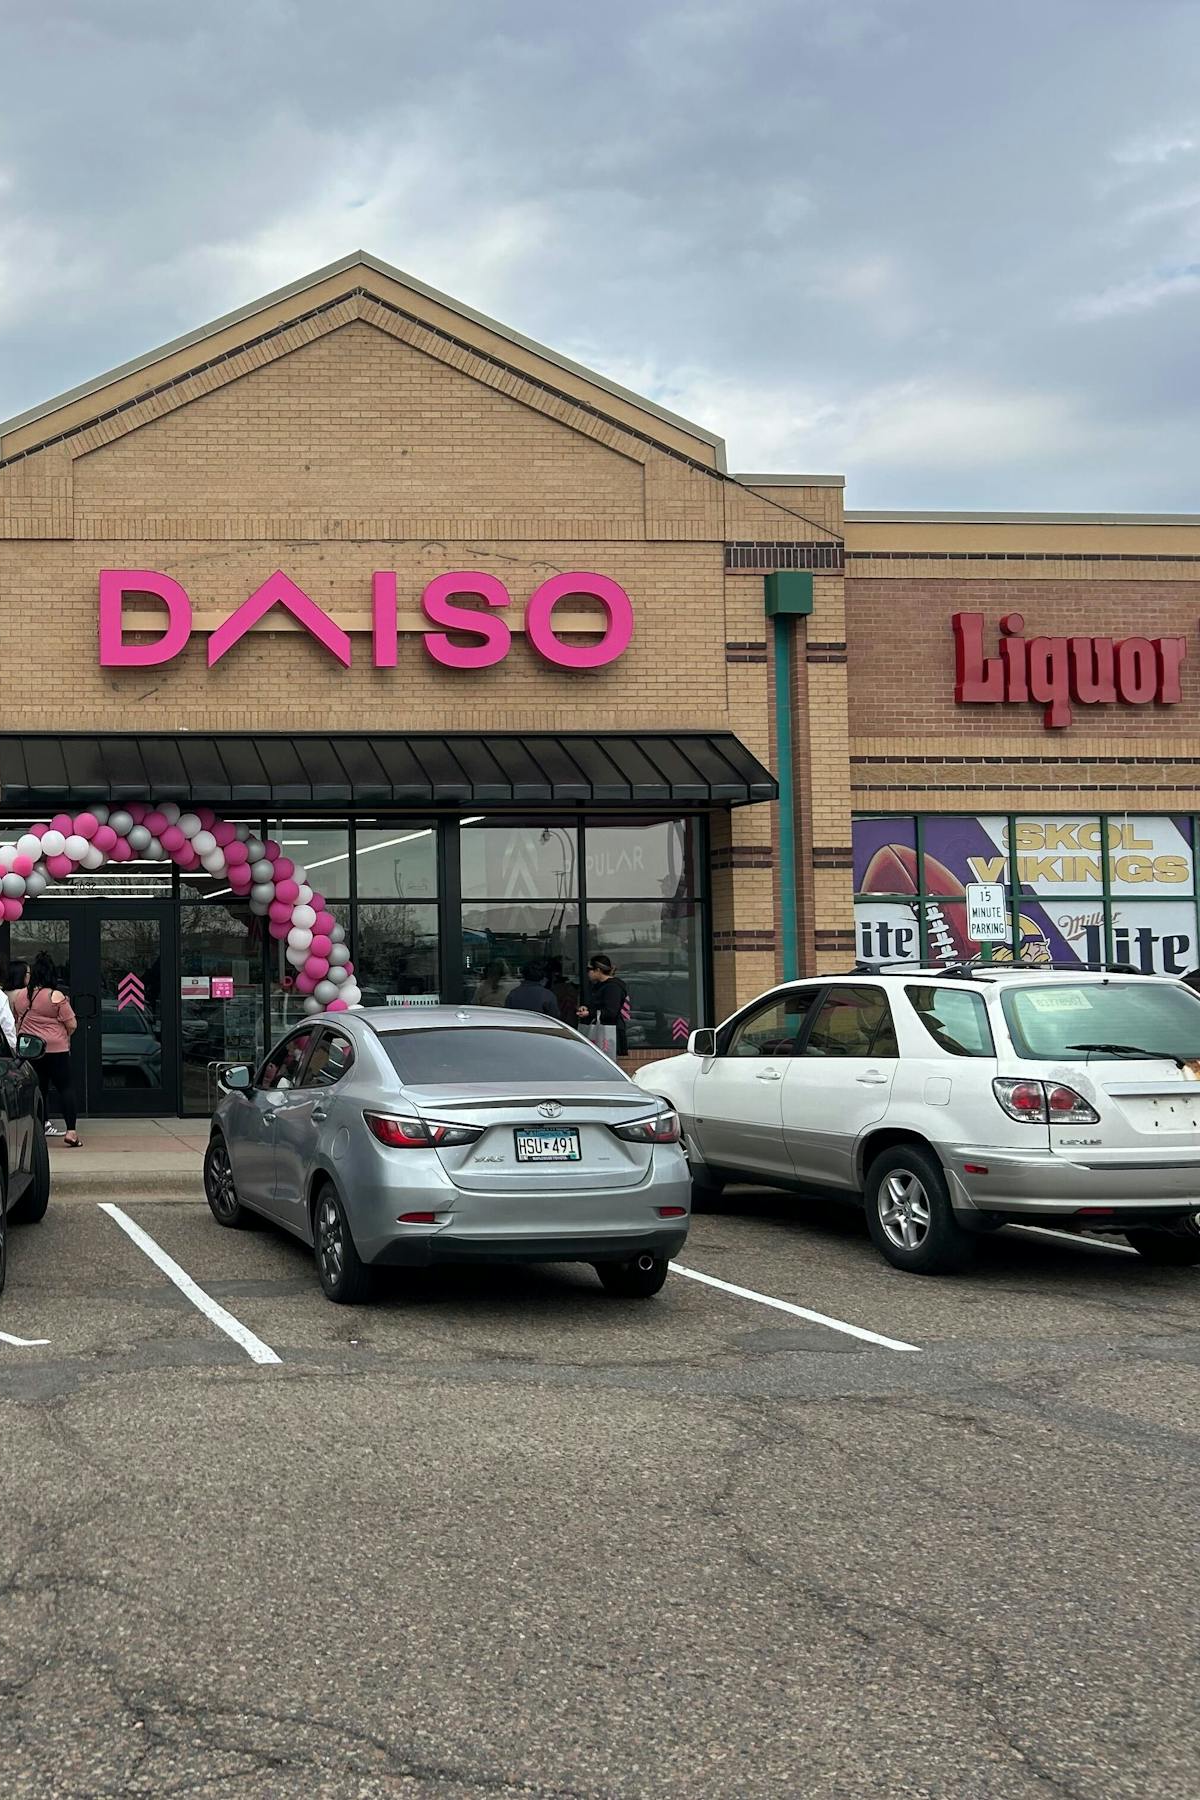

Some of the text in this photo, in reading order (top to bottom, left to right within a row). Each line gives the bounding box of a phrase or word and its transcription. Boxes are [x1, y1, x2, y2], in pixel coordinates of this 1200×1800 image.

[100, 569, 634, 668] DAISO
[952, 613, 1187, 729] Liquor
[1002, 823, 1153, 850] SKOL
[966, 855, 1190, 883] VIKINGS
[979, 890, 992, 902] 15
[972, 907, 1002, 919] MINUTE
[1058, 911, 1121, 938] Millr
[972, 924, 1005, 935] PARKING
[518, 1137, 576, 1154] HSU 491
